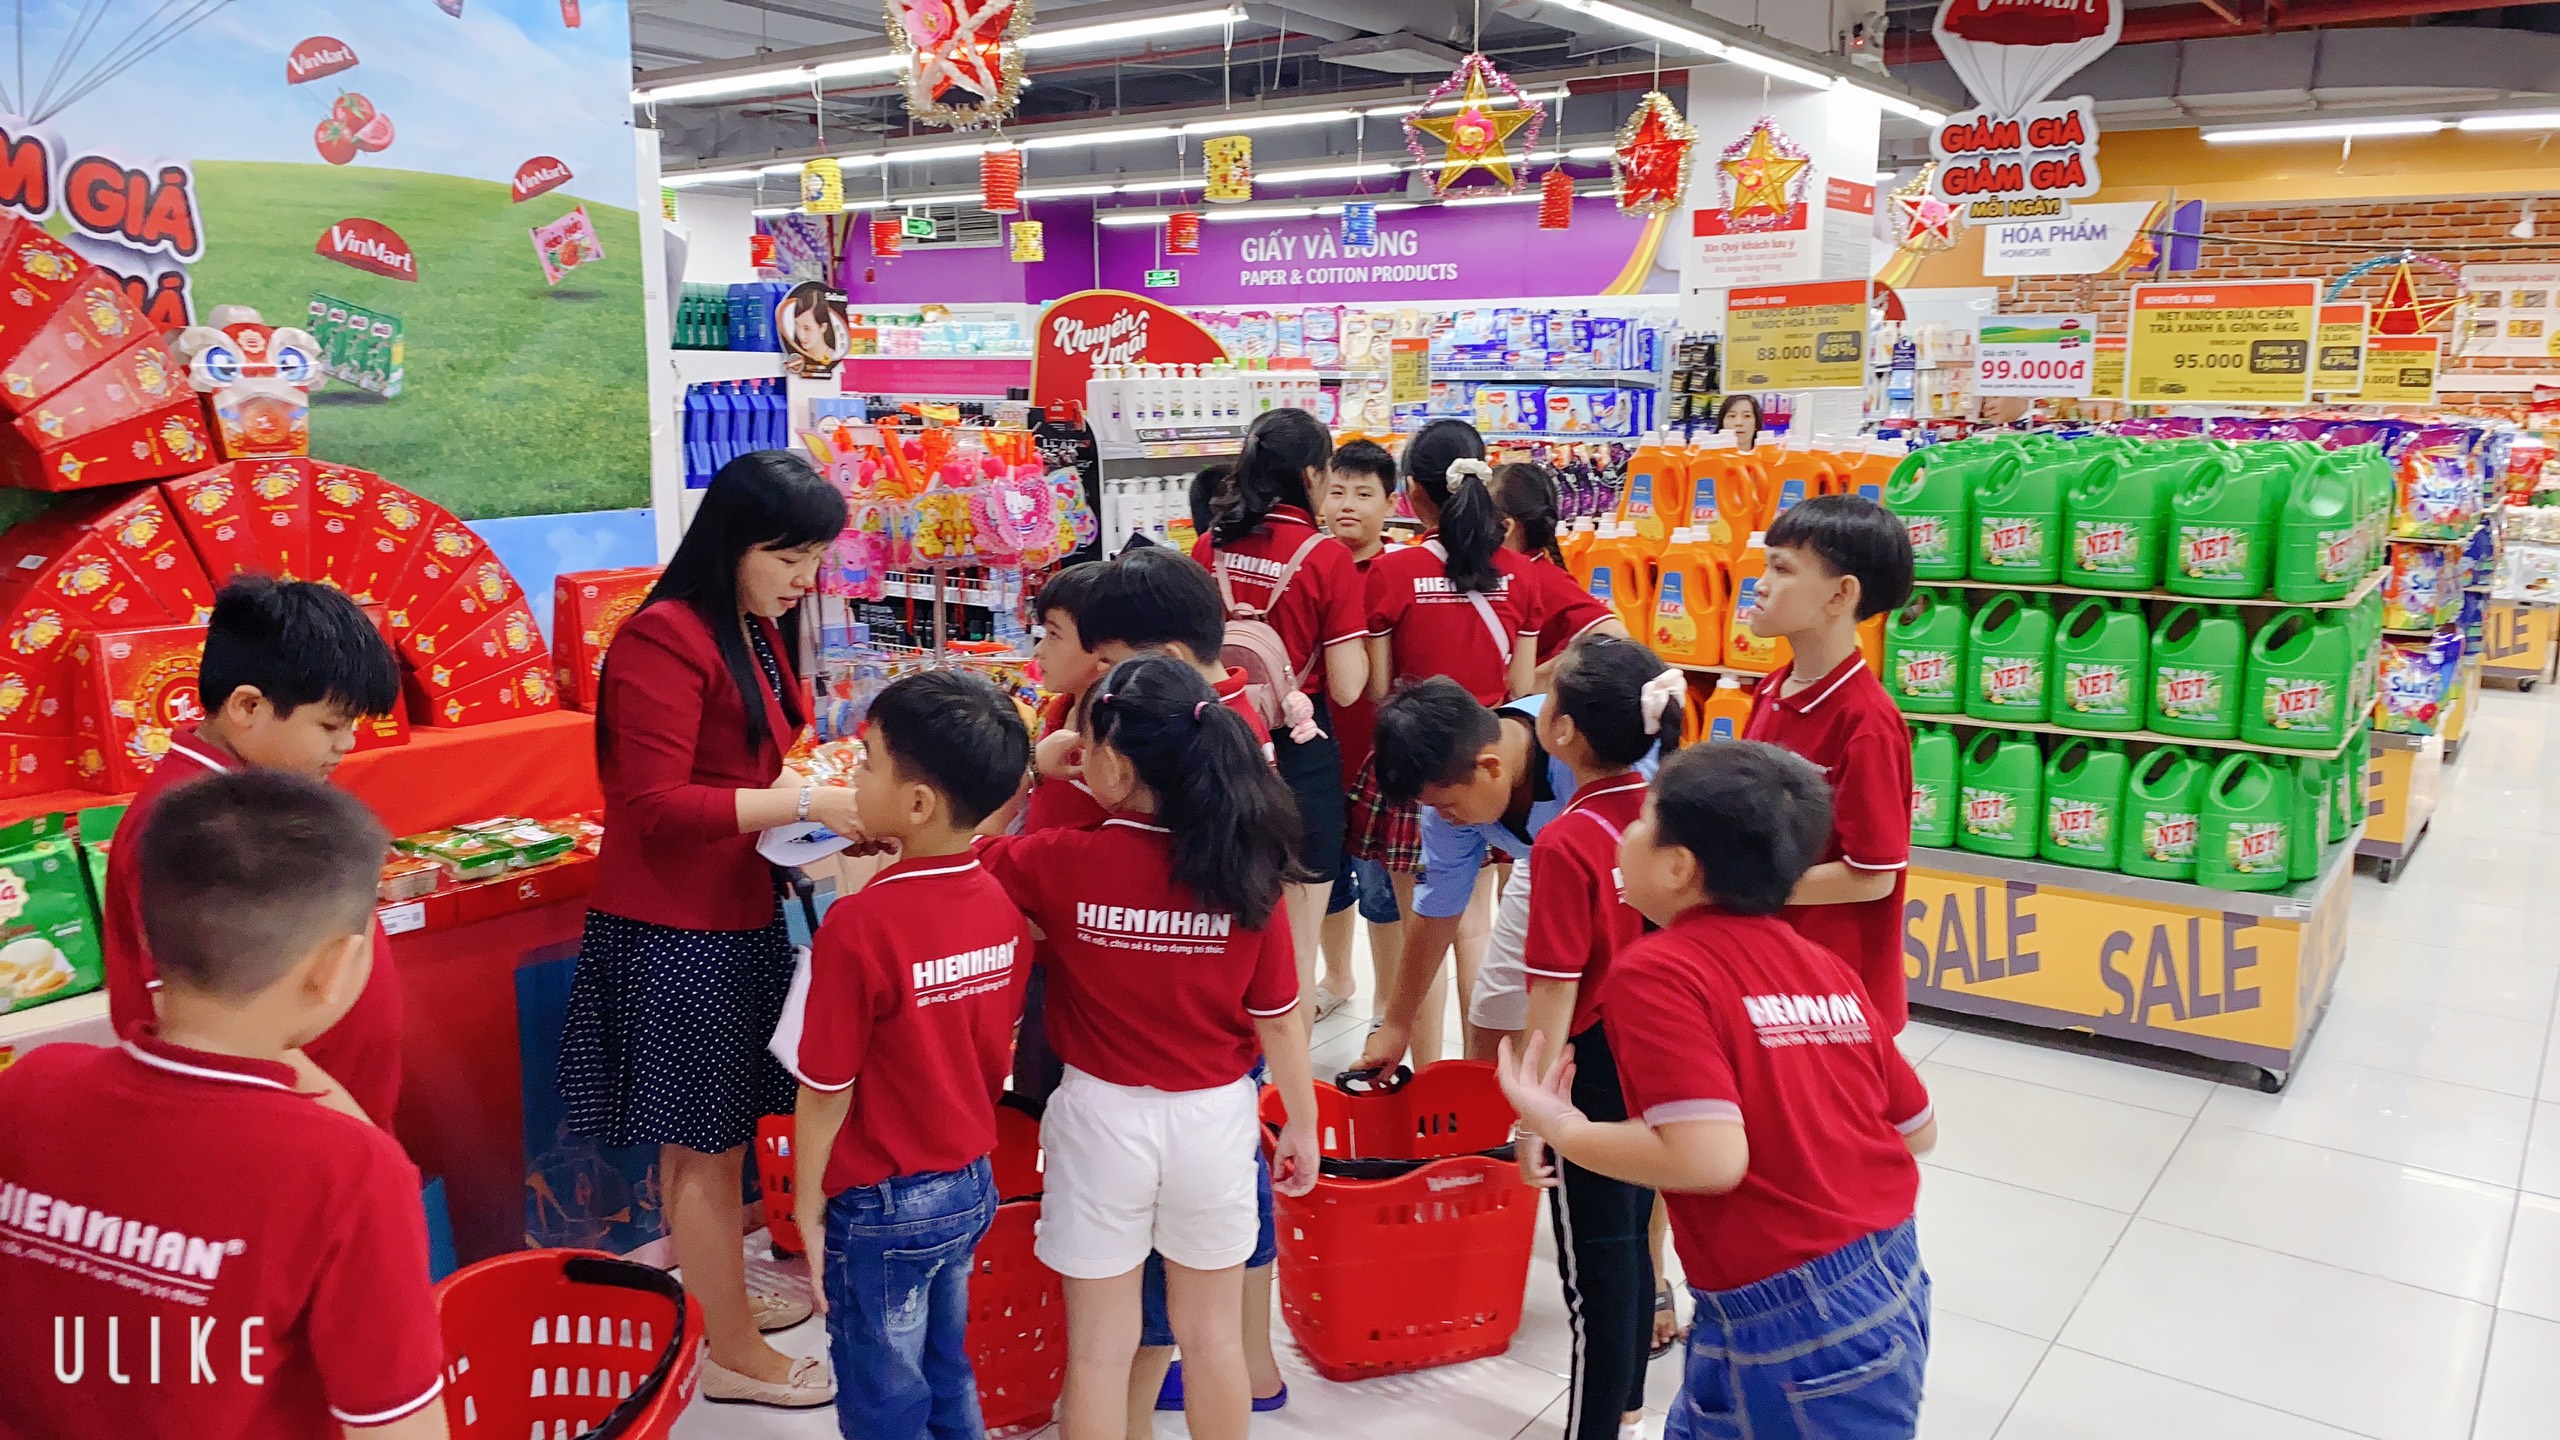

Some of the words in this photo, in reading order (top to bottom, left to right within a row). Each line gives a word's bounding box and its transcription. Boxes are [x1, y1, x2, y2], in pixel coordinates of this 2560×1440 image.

[288, 46, 353, 75] VinMart
[1941, 115, 2021, 153] GIẢM
[2028, 110, 2085, 148] GIÁ
[514, 162, 569, 194] VinMart
[1942, 158, 2024, 195] GIẢM
[2030, 153, 2086, 190] GIÁ
[65, 155, 198, 257] GIÁ
[1970, 196, 2004, 218] MỖI
[2009, 195, 2060, 217] NGÀY!
[2002, 223, 2042, 244] HÓA
[2050, 218, 2107, 242] PHẨM
[331, 225, 412, 273] VinMart
[1240, 229, 1298, 262] GIẤY
[1303, 228, 1338, 260] VÀ
[2000, 248, 2053, 258] HOMECARE
[1240, 270, 1287, 286] PAPER
[1290, 270, 1302, 285] &
[1306, 267, 1368, 284] COTTON
[1372, 263, 1458, 282] PRODUCTS
[2155, 311, 2180, 321] NET
[2183, 308, 2223, 321] NƯỚC
[1053, 308, 1151, 364] Khuyến
[2177, 323, 2211, 333] XANH
[2217, 324, 2227, 333] &
[2272, 322, 2300, 332] 4KG
[1757, 346, 1812, 361] 88.000
[1818, 343, 1859, 357] 48%
[2174, 353, 2243, 369] 95.000
[2291, 345, 2300, 355] 1
[1981, 360, 2086, 380] 99.000đ
[1629, 503, 1650, 514] LIX
[1694, 508, 1715, 519] LIX
[1908, 523, 1933, 546] ET
[1993, 525, 2027, 551] NET
[2086, 530, 2123, 556] NET
[2191, 535, 2230, 563] NET
[1660, 601, 1679, 614] LIX
[1908, 658, 1942, 682] NET
[1993, 665, 2029, 690] NET
[2077, 673, 2114, 697] NET
[2168, 678, 2205, 702] NET
[2392, 675, 2433, 693] Surf
[2277, 688, 2320, 714] NET
[1970, 798, 2001, 821] NET
[2058, 808, 2093, 832] NET
[2158, 821, 2196, 847] NET
[2241, 829, 2276, 858] NET
[1076, 902, 1231, 937] HIENNHAN
[1905, 880, 2040, 990] SALE
[2100, 911, 2261, 1024] SALE
